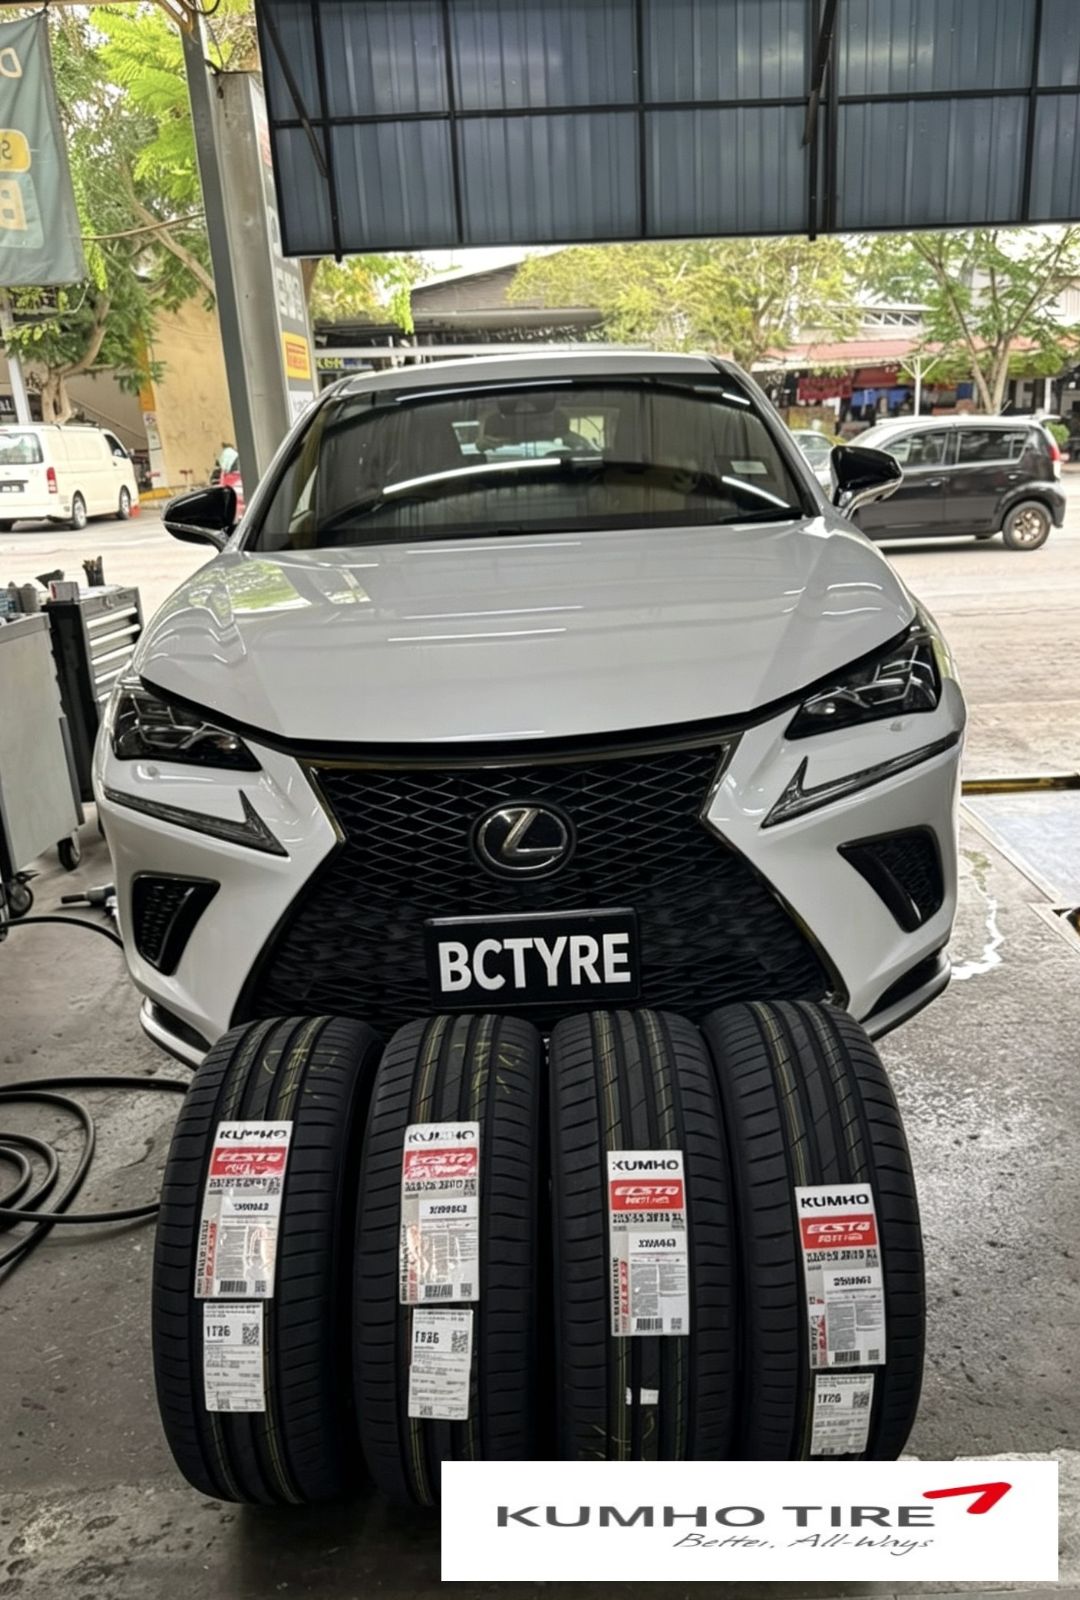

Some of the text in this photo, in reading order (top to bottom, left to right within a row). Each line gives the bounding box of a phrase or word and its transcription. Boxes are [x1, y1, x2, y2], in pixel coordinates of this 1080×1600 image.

[437, 932, 632, 993] BCTYRE
[612, 1159, 680, 1171] KUMHO
[800, 1193, 870, 1208] KUMHO
